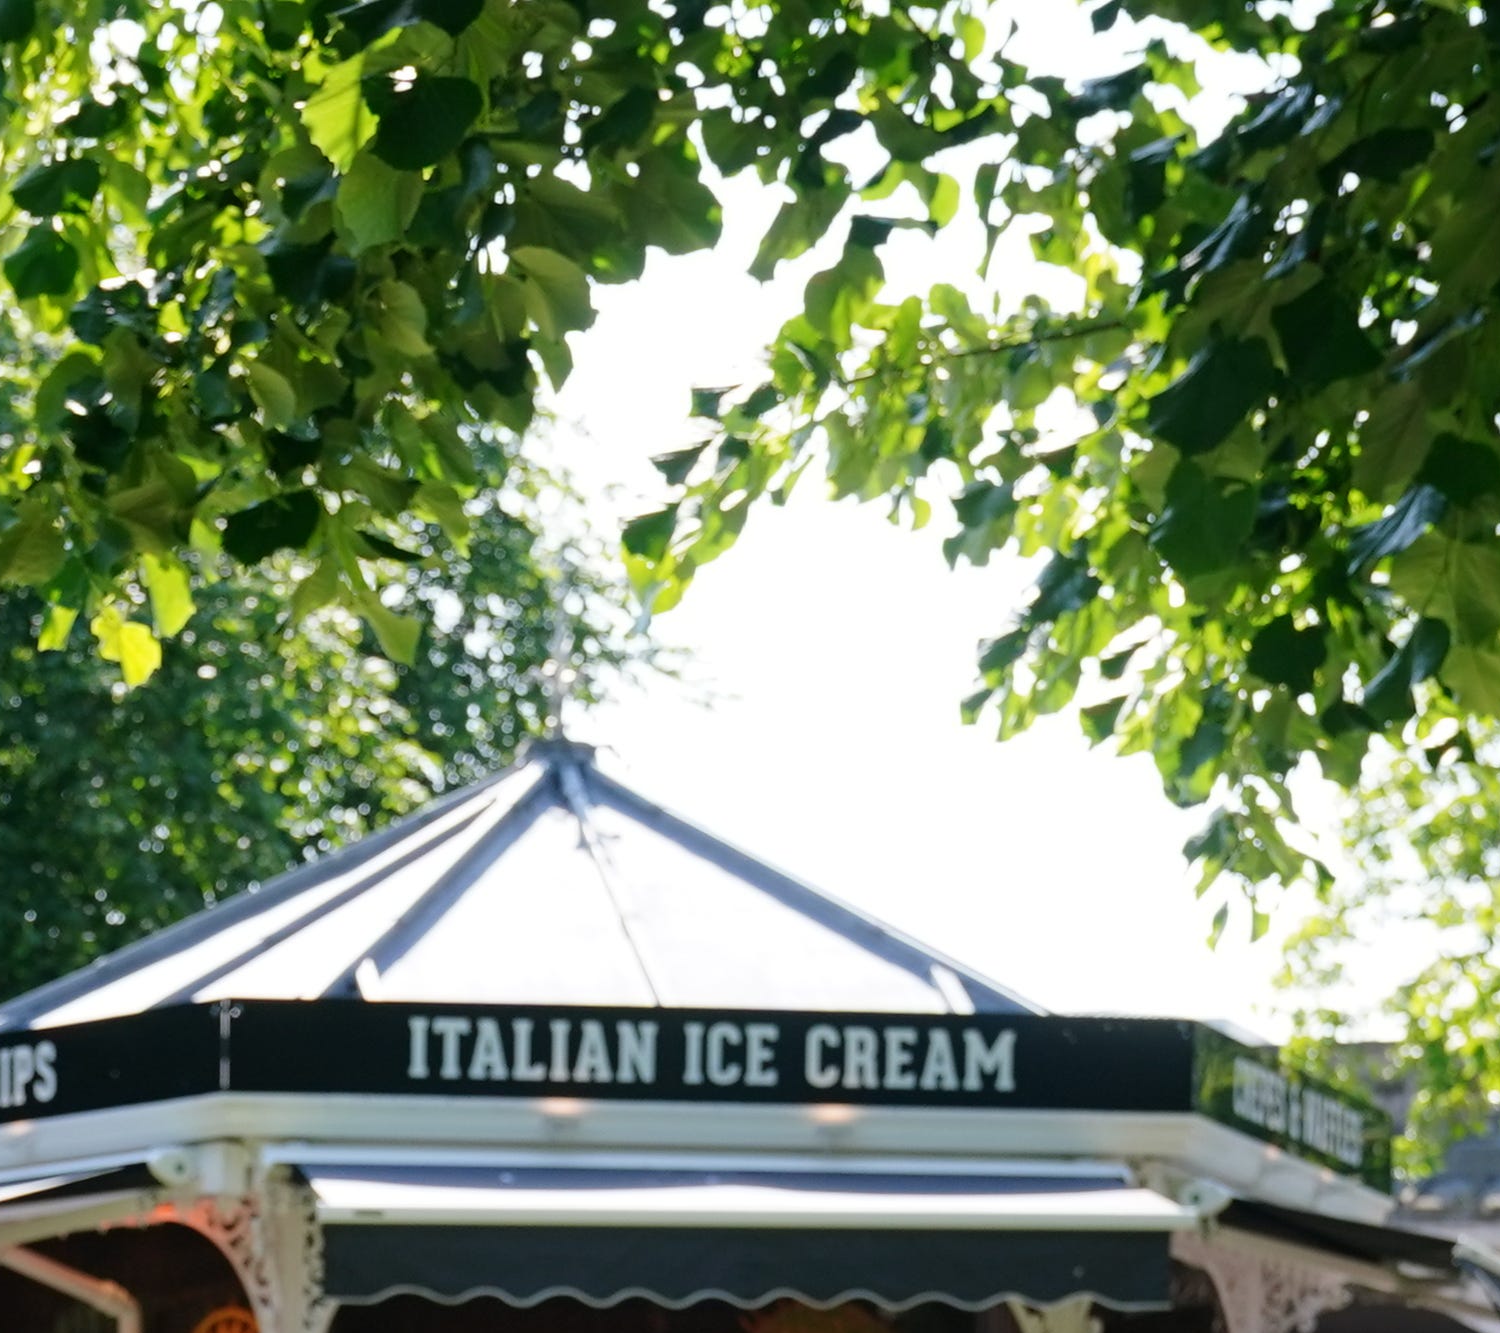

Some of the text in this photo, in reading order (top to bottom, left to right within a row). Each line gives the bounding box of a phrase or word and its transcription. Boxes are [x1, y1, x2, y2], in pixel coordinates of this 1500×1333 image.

[407, 1015, 1017, 1093] ITALIAN ICE CREAM
